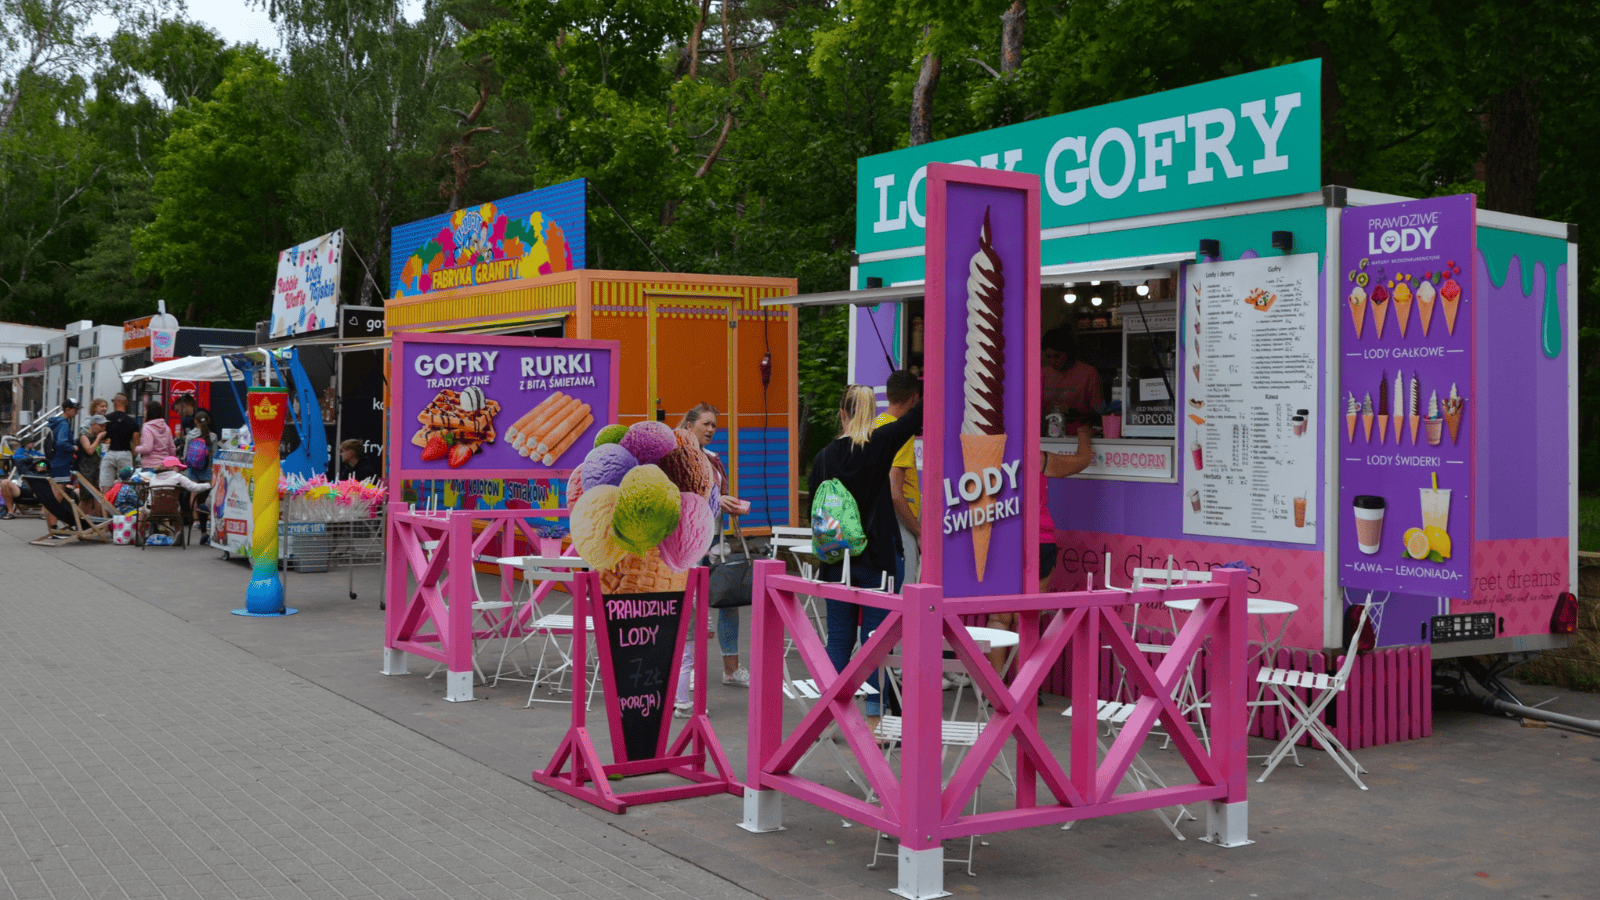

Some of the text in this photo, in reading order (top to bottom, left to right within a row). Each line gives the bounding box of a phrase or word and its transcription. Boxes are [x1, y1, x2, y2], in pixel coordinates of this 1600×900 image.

[1045, 92, 1302, 206] GOFRY
[1368, 212, 1439, 230] PRAWDZIWE
[1368, 226, 1438, 255] LODY
[432, 258, 519, 290] FABRYKA GRANITY
[414, 351, 499, 376] GOFRY
[1364, 347, 1444, 359] LODY GAŁKOWE
[521, 353, 592, 377] RURKI
[426, 375, 490, 389] TRADYCYJNE
[519, 376, 595, 391] Z BITĄ ŚMIETANĄ
[1105, 452, 1166, 469] POPCORN
[1366, 453, 1441, 467] LODY ŚWIDERKI
[943, 459, 1020, 507] LODY
[943, 497, 1020, 535] ŚWIDERKI
[1353, 561, 1458, 581] KAWA LEMONIADA
[1507, 570, 1561, 590] dreams
[606, 599, 678, 621] PRAWDZIWE
[619, 624, 660, 647] LODY
